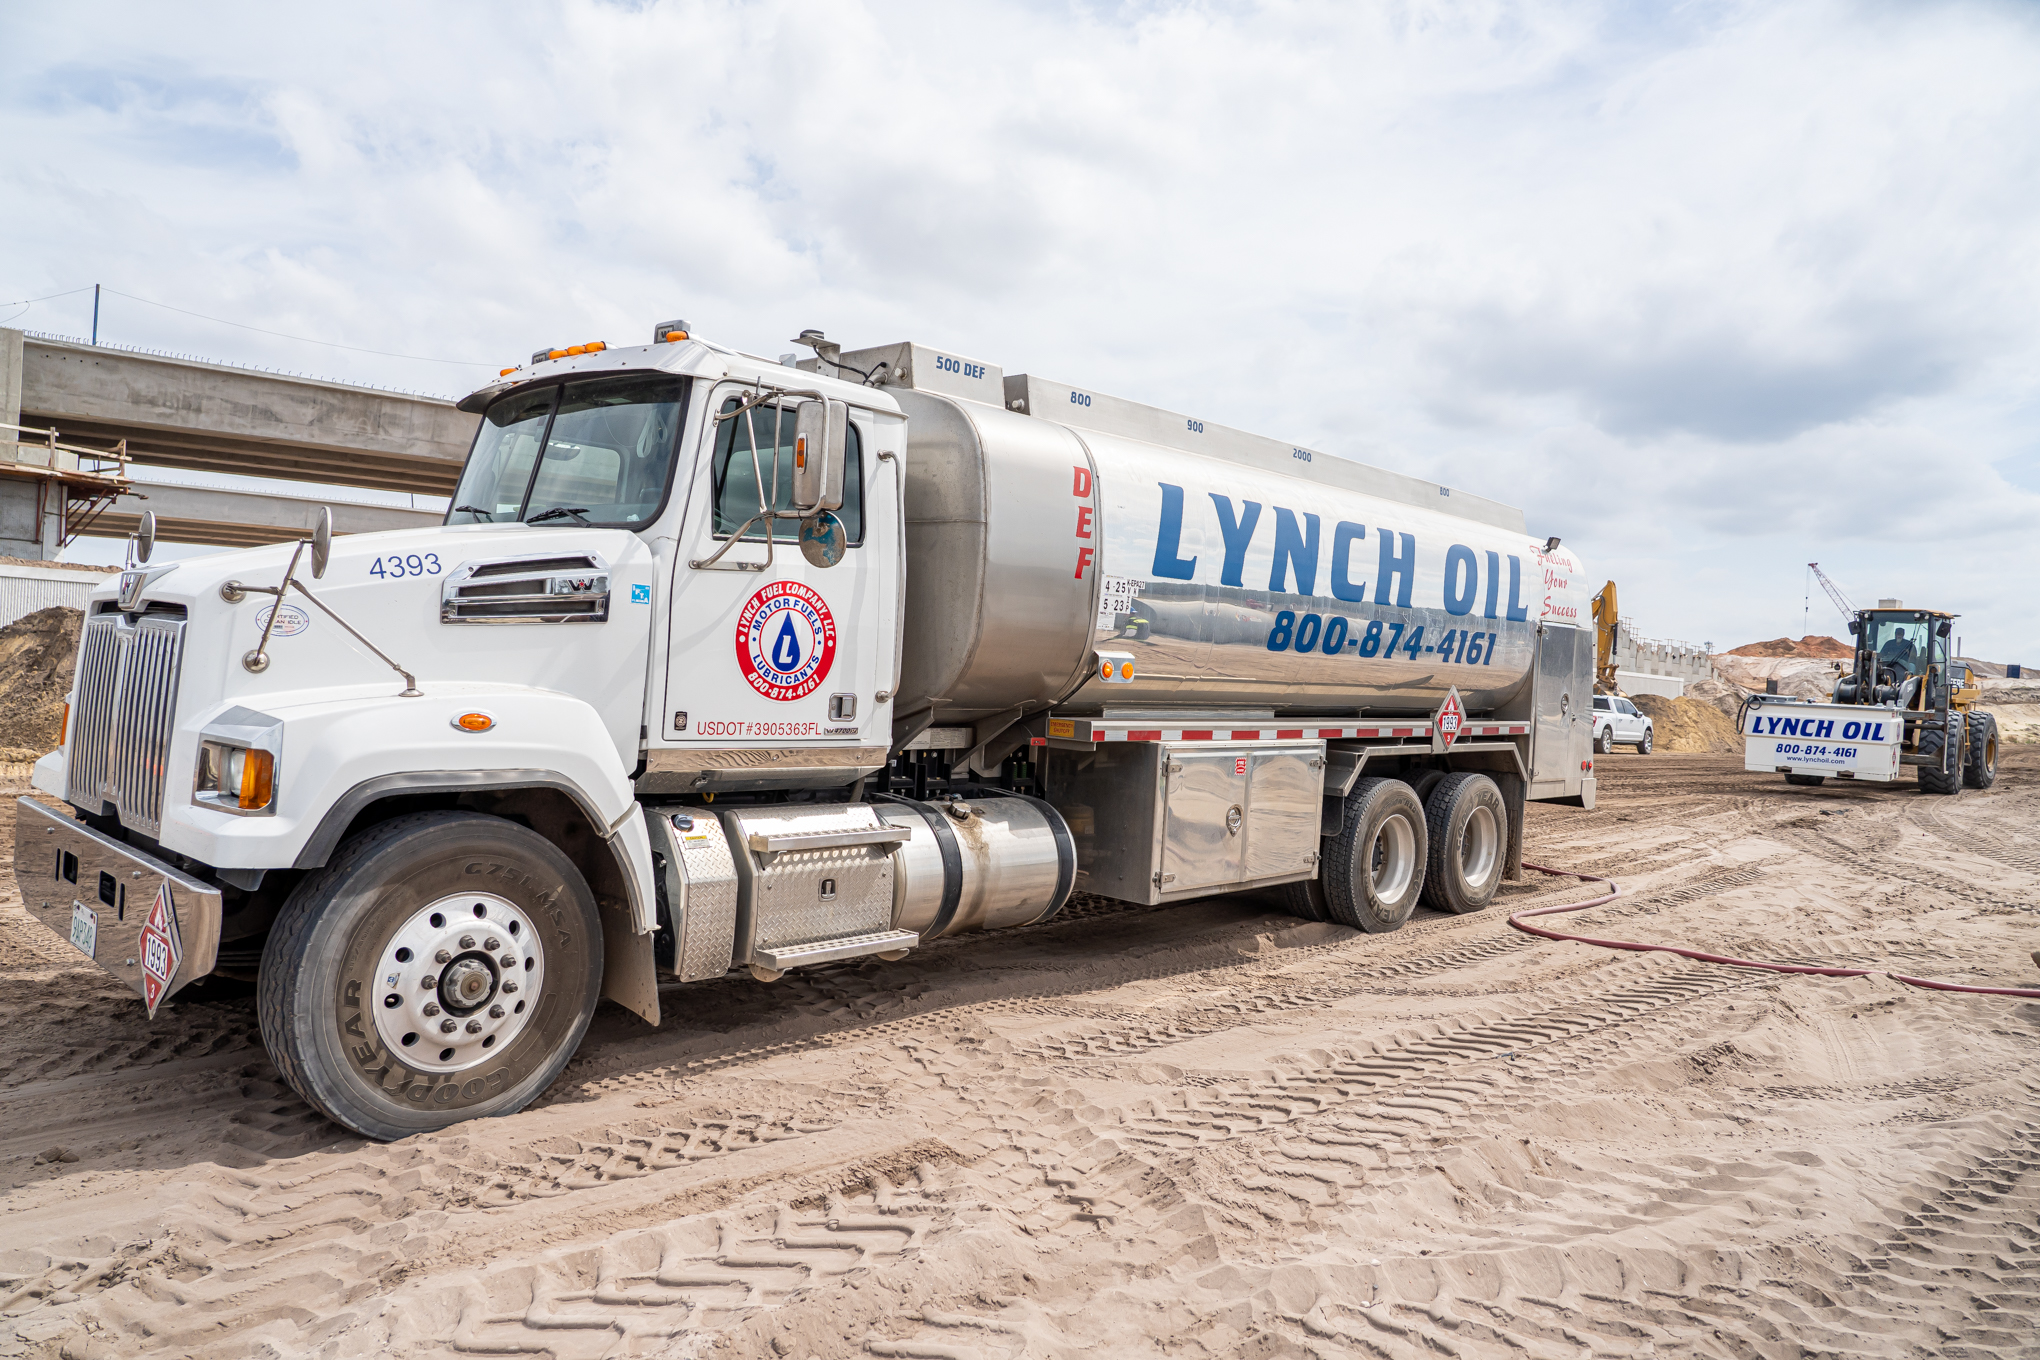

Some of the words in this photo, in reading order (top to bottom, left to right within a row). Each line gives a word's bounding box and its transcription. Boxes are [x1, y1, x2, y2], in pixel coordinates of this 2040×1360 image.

[936, 355, 961, 374] 500
[963, 363, 986, 380] DEF
[1070, 391, 1092, 407] 800
[1187, 419, 1204, 434] 900
[1293, 448, 1312, 463] 2000
[1152, 481, 1416, 609] LYNCH
[1443, 543, 1529, 622] OIL
[369, 553, 442, 579] 4393
[1544, 568, 1568, 591] Your
[739, 597, 762, 634] LYNCH
[761, 583, 784, 602] FUEL
[823, 619, 835, 638] LLC
[752, 598, 791, 632] MOTOR
[793, 600, 823, 636] FUELS
[1540, 595, 1578, 619] Success
[1266, 609, 1497, 666] 800-874-4161
[753, 654, 820, 685] LUBRICANTS
[1443, 716, 1458, 730] 1993
[1752, 716, 1835, 738] LYNCH
[1842, 721, 1885, 741] OIL
[1776, 743, 1858, 758] 800-874-4161
[1786, 756, 1846, 765] www.lynchoil.com
[146, 936, 168, 978] 1993
[150, 983, 156, 999] 3
